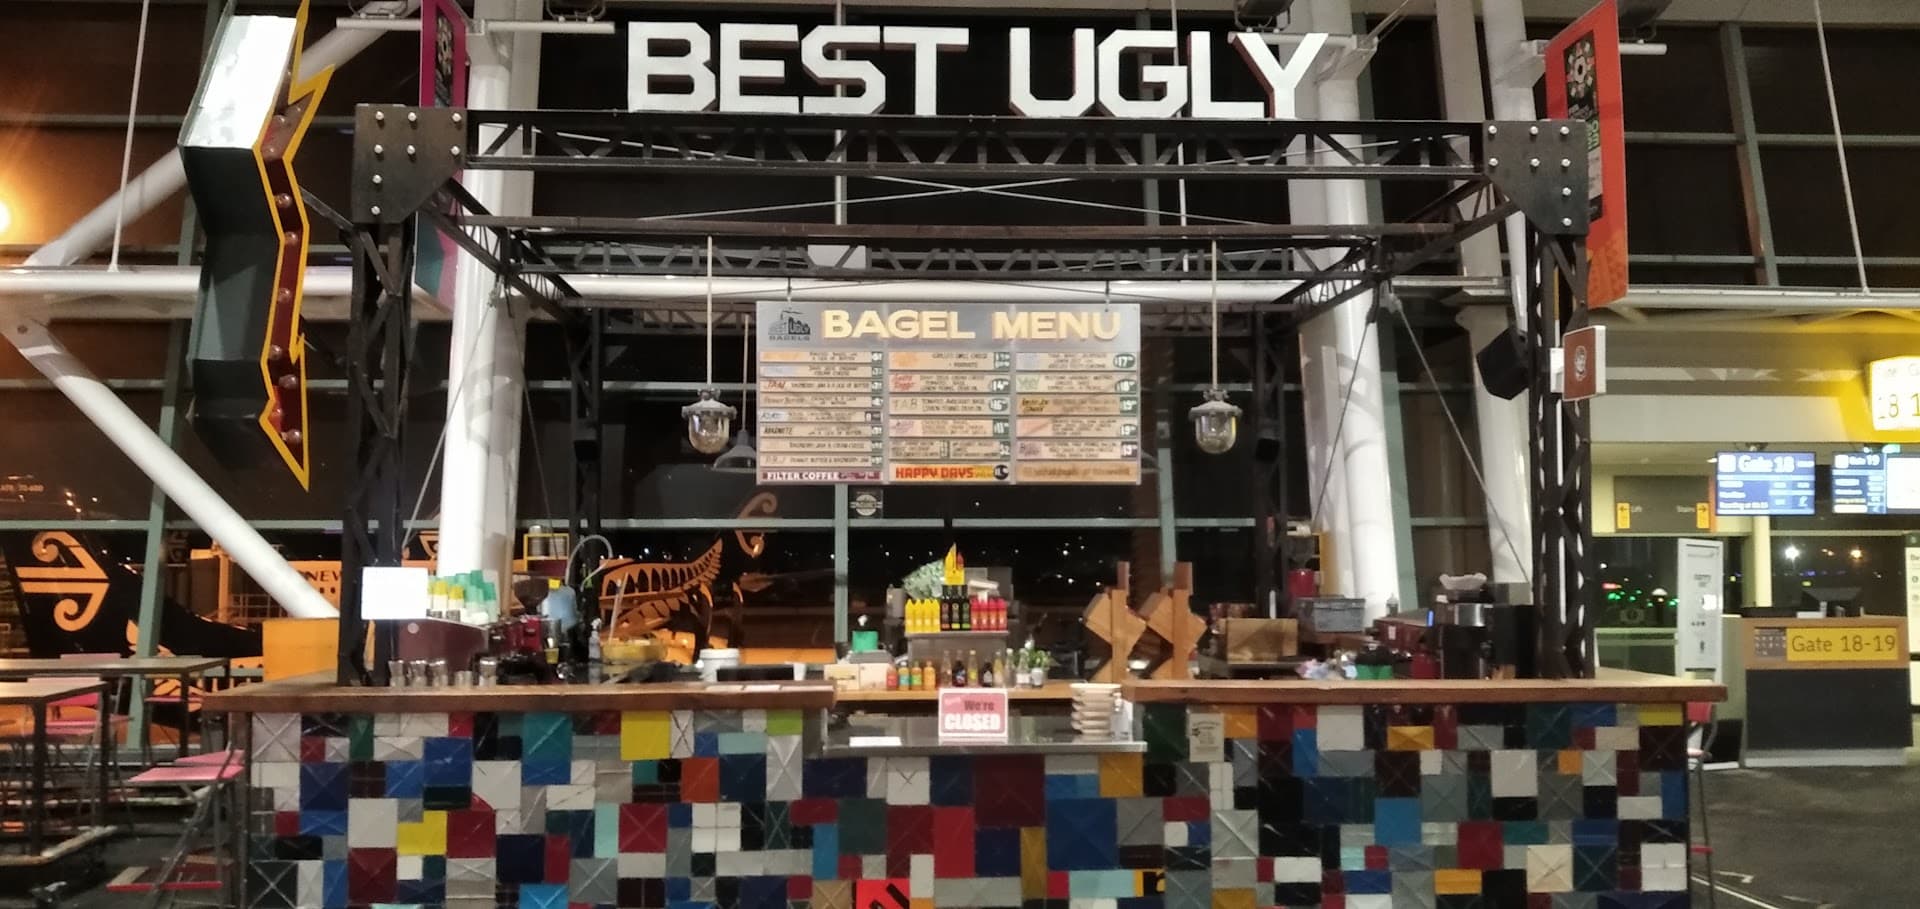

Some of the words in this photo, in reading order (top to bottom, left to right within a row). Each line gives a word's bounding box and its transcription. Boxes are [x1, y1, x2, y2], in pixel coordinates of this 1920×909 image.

[628, 21, 969, 113] BEST
[1009, 27, 1328, 119] UGLY
[822, 309, 976, 339] BAGEL
[993, 311, 1121, 341] MENU
[1738, 454, 1774, 473] Gate
[1866, 455, 1881, 466] 19
[767, 472, 801, 480] FILTER
[801, 472, 840, 480] COFFEE
[895, 467, 938, 479] HAPPY
[940, 467, 974, 479] DAYS
[1791, 635, 1833, 653] Gate
[1840, 634, 1896, 653] 18-19
[944, 713, 1001, 731] CLOSED
